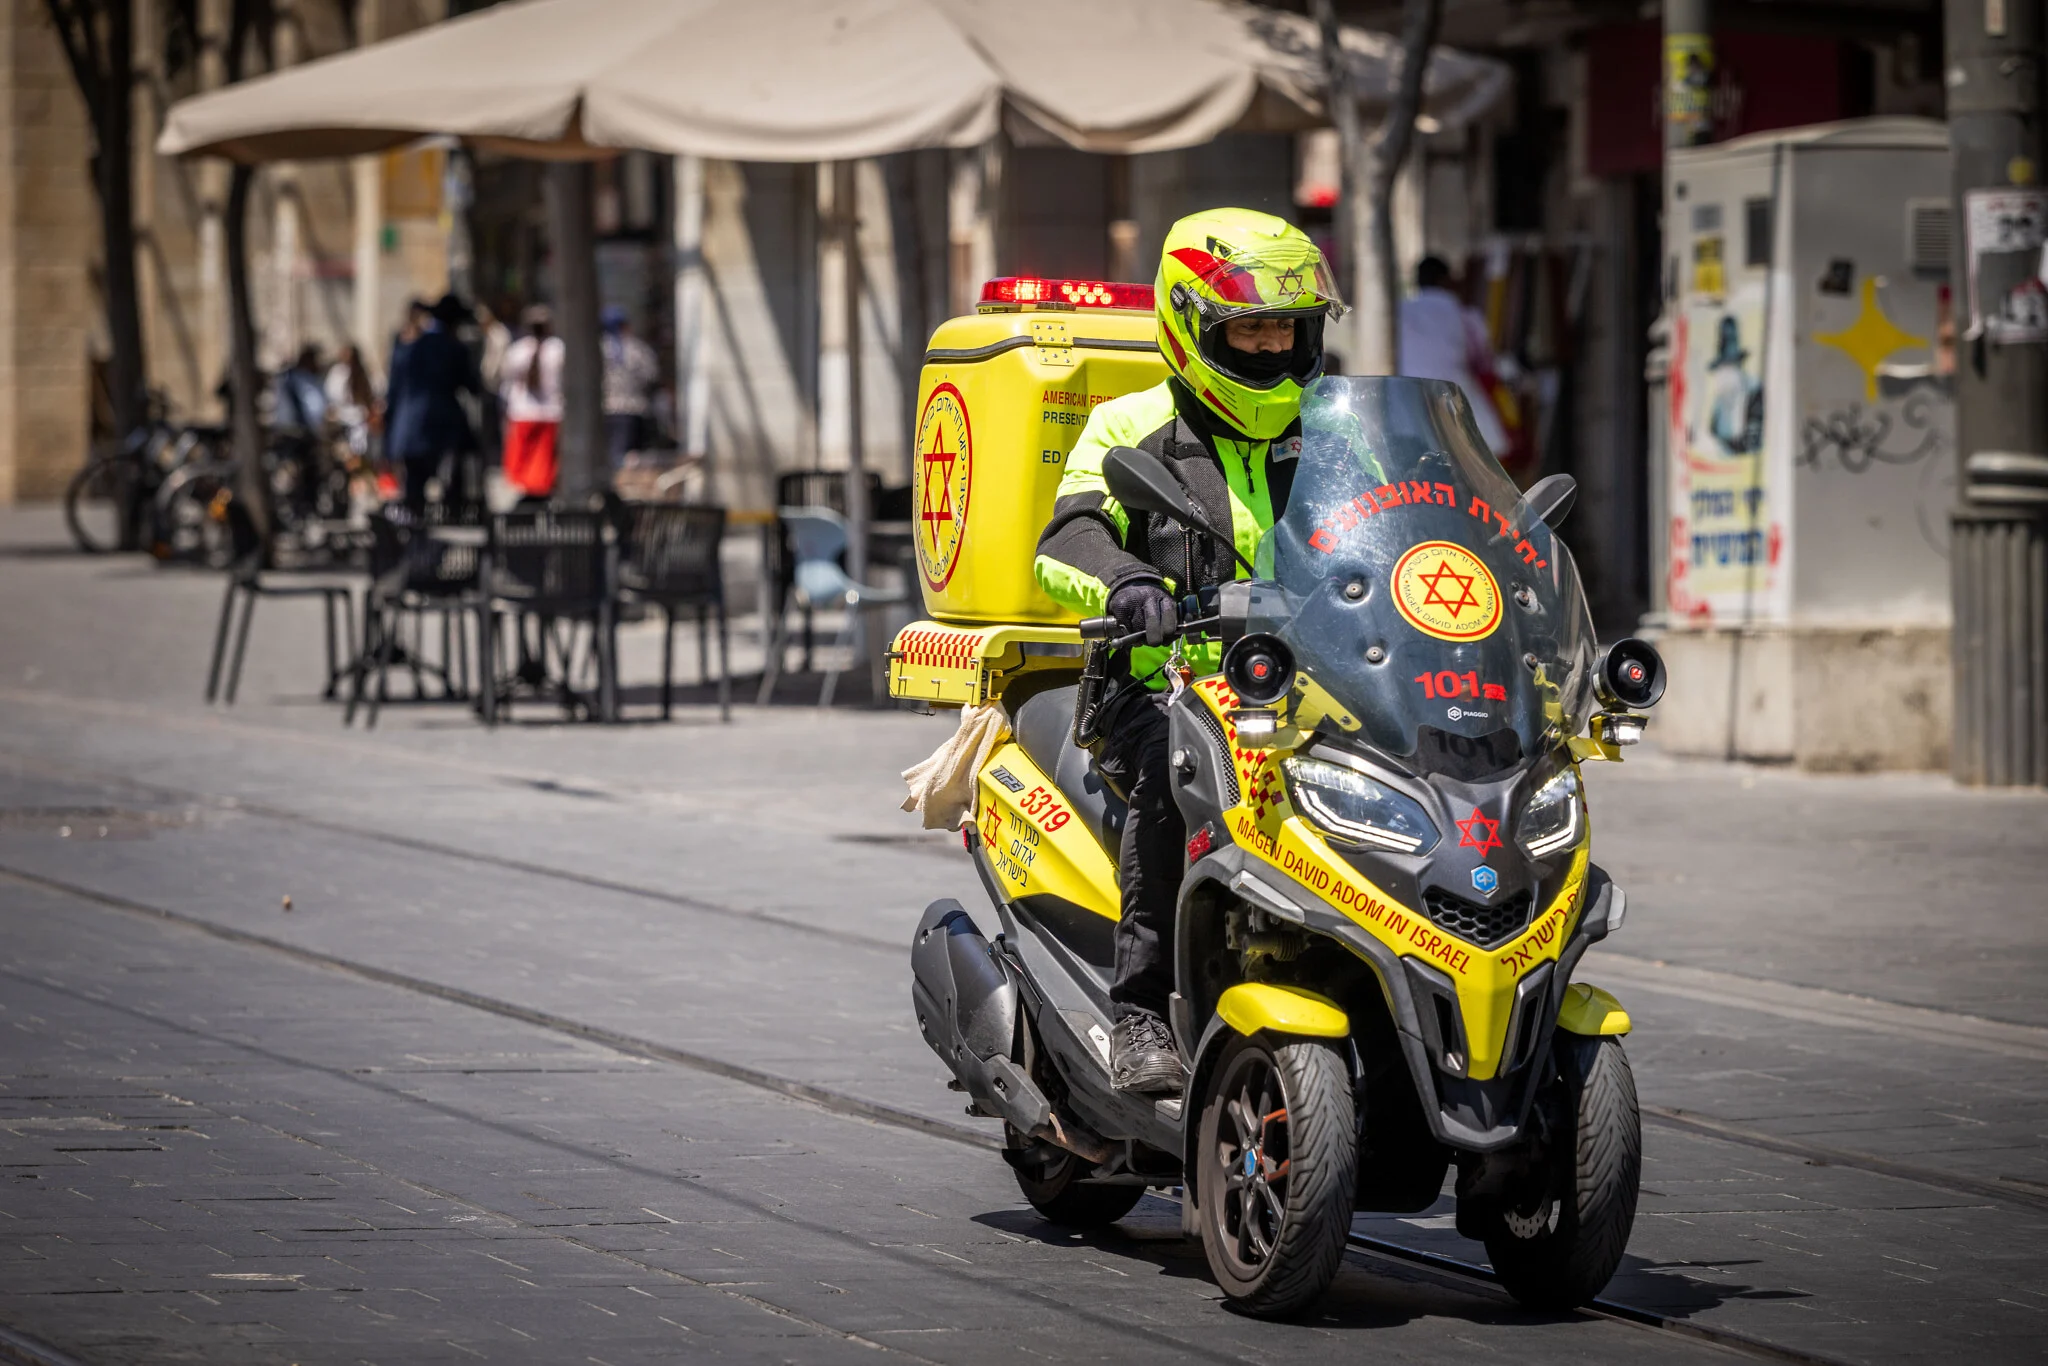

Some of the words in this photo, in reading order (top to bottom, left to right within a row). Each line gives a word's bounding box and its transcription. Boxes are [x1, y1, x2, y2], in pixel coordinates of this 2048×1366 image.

[1042, 390, 1087, 407] AMERICAN
[1043, 411, 1090, 426] PRESENT
[1042, 449, 1061, 464] ED
[954, 471, 968, 535] ISRAEL
[1307, 480, 1457, 555] האופנועים
[1468, 495, 1548, 569] יחידת
[1403, 584, 1423, 614] MAGEN
[1422, 612, 1452, 629] DAVID
[1455, 618, 1482, 631] ADOM
[1414, 670, 1480, 699] 101
[1009, 811, 1023, 835] דוד
[1019, 785, 1071, 833] 5319
[1010, 839, 1036, 867] אדום
[1023, 824, 1040, 847] מגן
[996, 847, 1028, 887] בישראל
[1237, 816, 1282, 861] MAGEN
[1283, 850, 1329, 890] DAVID
[1330, 880, 1385, 921] ADOM
[1384, 911, 1410, 935] IN
[1408, 925, 1470, 975] ISRAEL
[1501, 908, 1569, 977] בישראל
